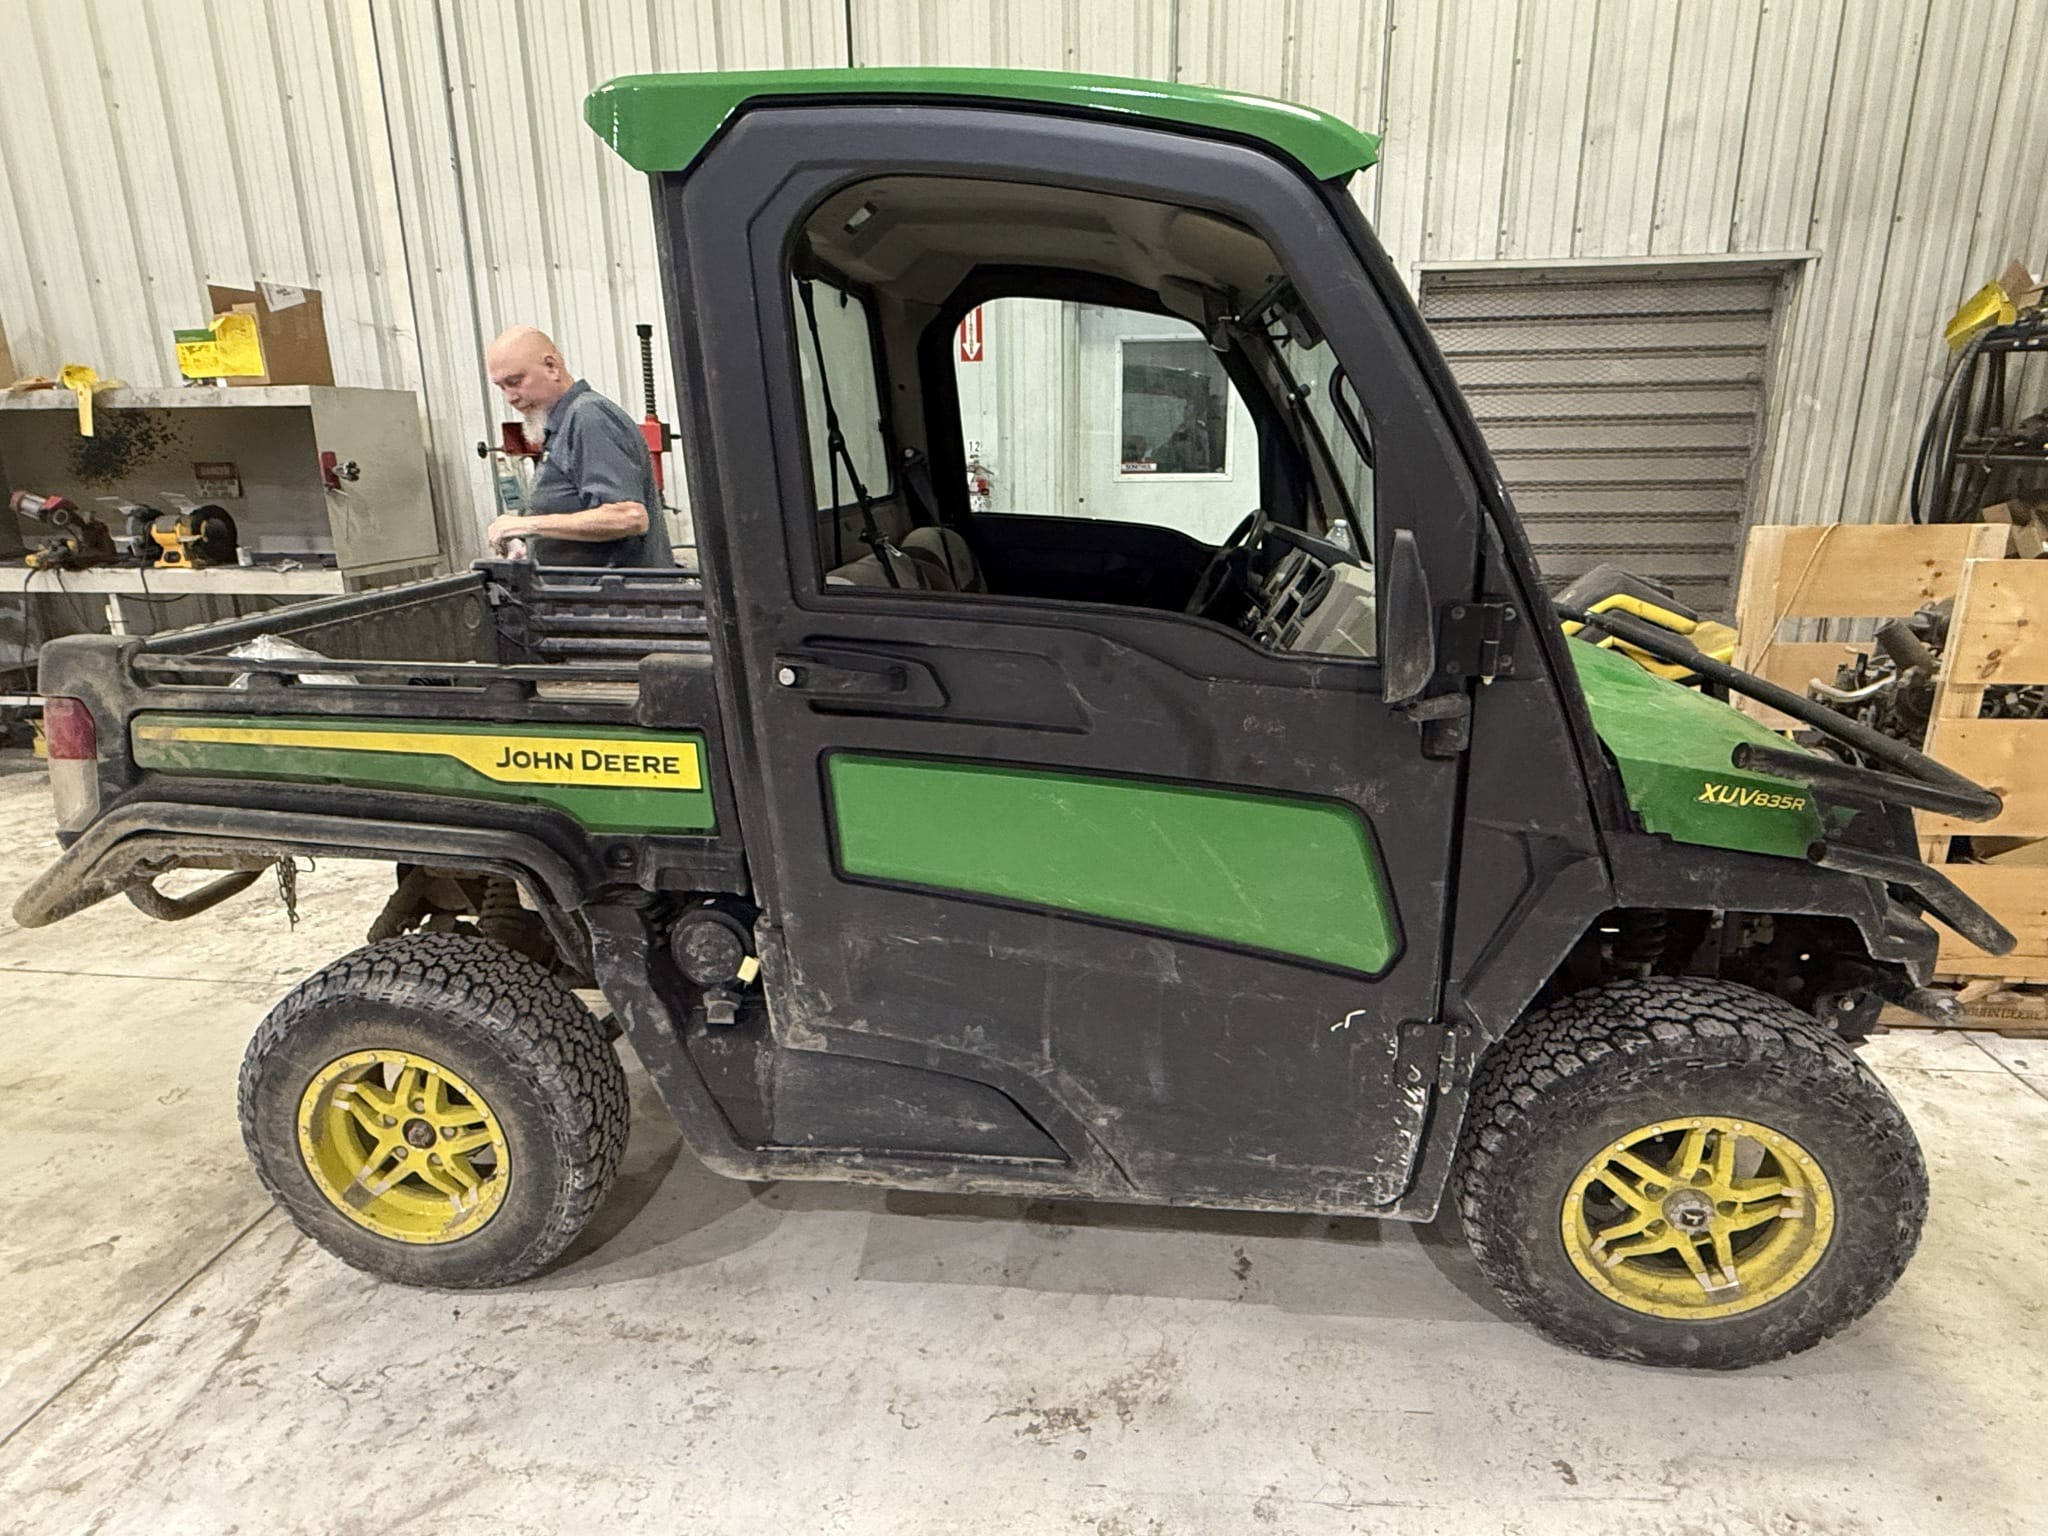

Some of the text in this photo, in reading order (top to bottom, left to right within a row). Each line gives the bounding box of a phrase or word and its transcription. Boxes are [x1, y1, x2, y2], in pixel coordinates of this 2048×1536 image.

[968, 441, 980, 452] 12
[496, 746, 680, 775] JOHN DEERE
[1698, 782, 1806, 811] XUV835R
